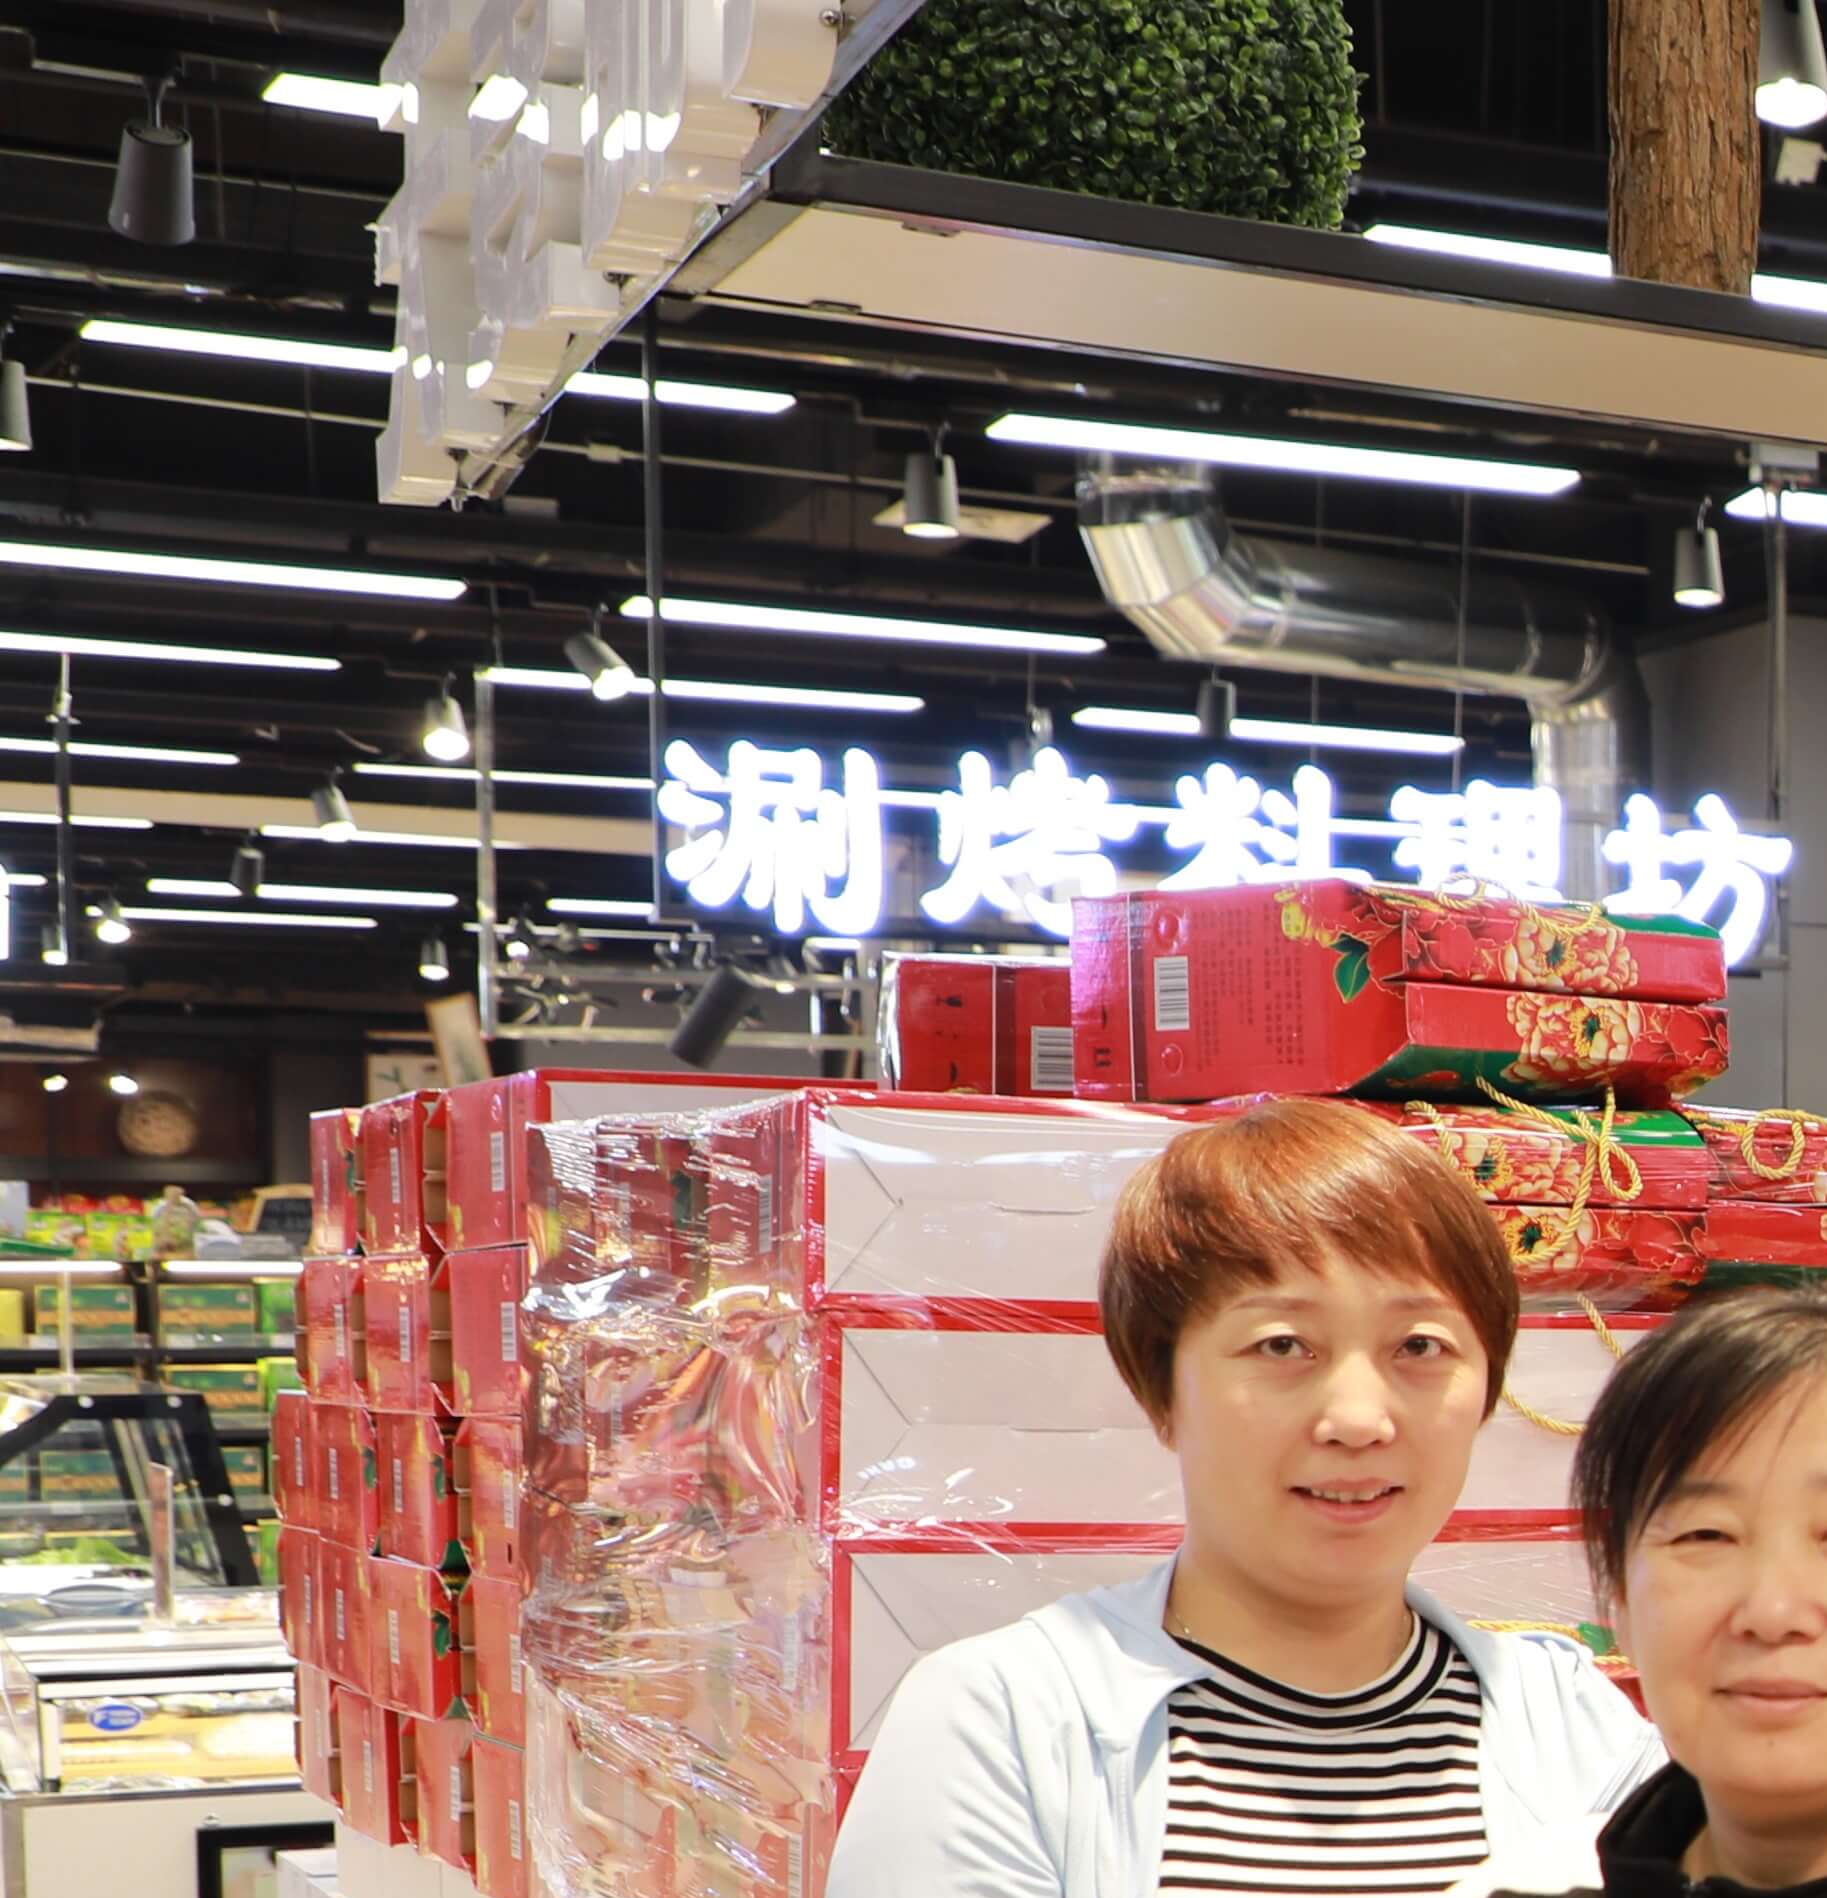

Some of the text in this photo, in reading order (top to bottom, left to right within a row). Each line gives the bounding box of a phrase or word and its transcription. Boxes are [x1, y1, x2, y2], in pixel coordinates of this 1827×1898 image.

[657, 738, 1794, 968] 涮烤料理坊
